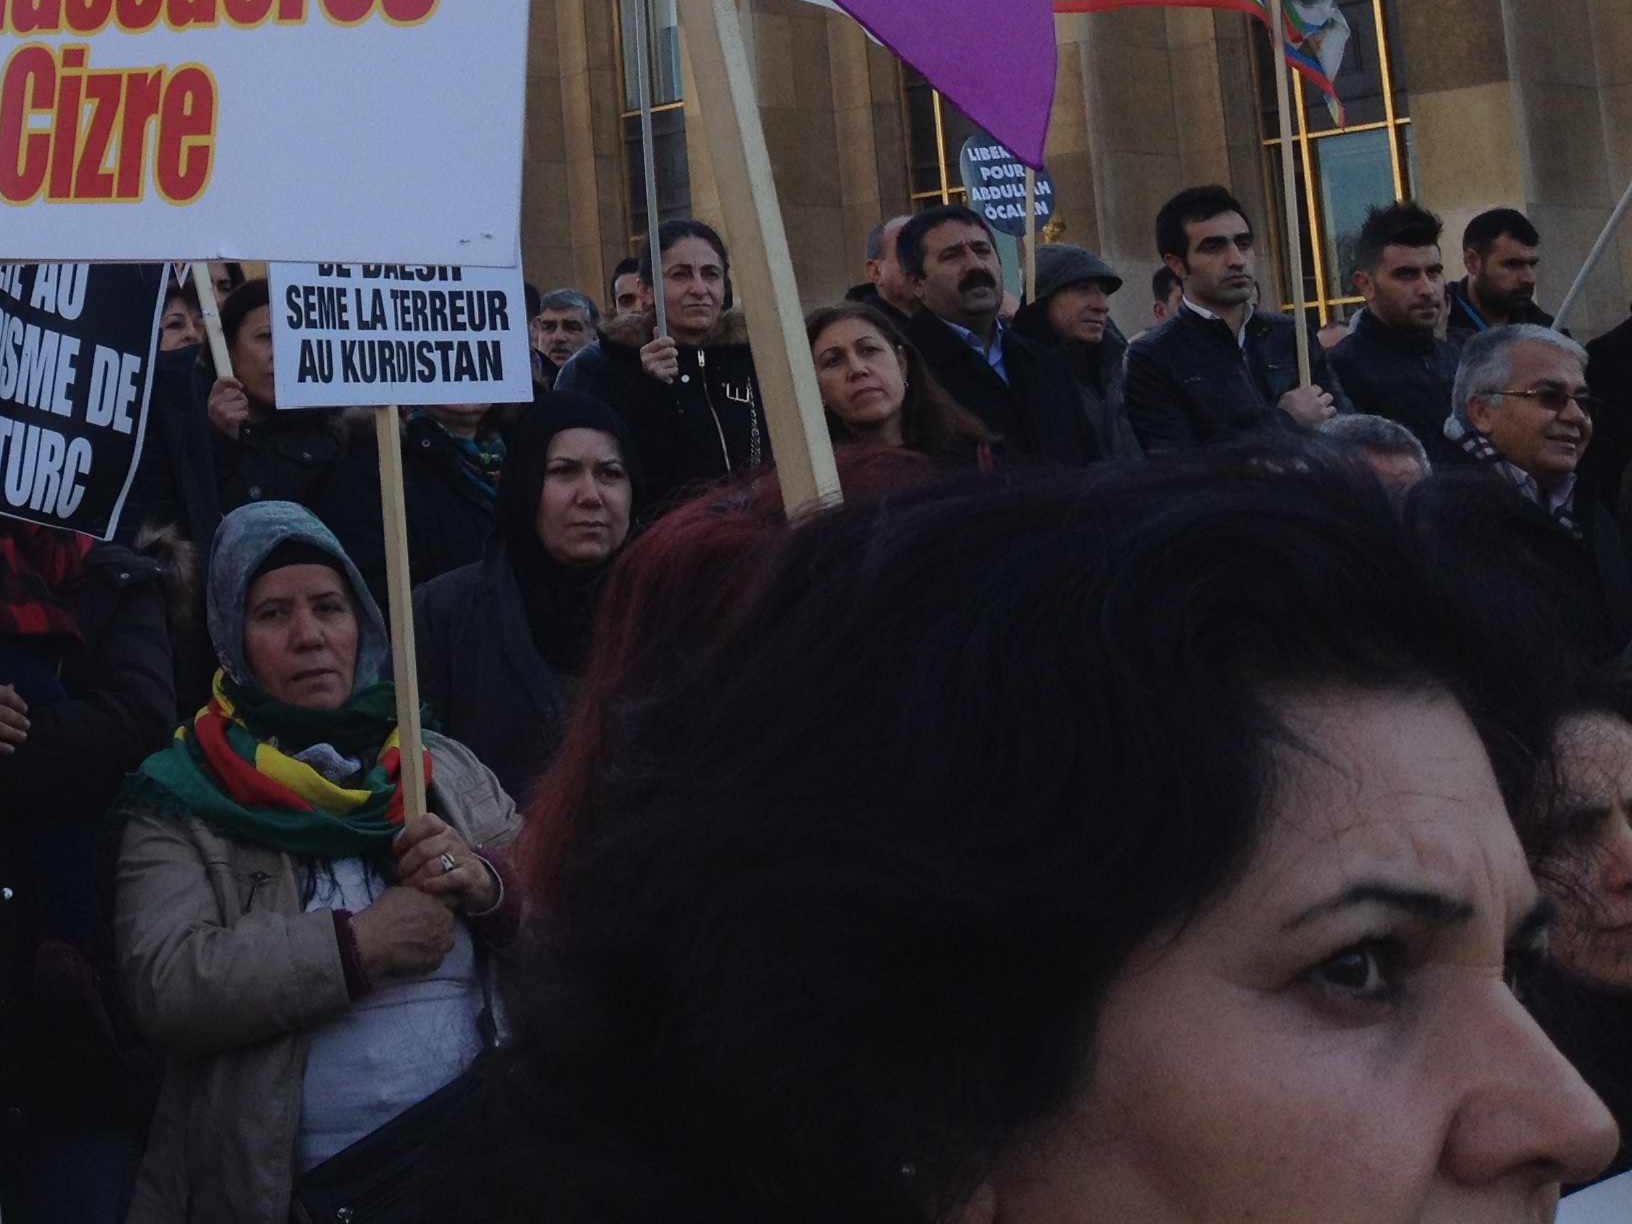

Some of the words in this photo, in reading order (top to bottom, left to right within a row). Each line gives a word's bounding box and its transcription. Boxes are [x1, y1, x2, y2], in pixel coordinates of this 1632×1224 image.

[972, 181, 1051, 201] ABDULLH
[979, 164, 1026, 180] POUR
[984, 201, 1049, 220] ÖCALN
[30, 264, 89, 320] AU
[286, 284, 349, 330] SEME
[355, 287, 388, 331] LA
[390, 288, 510, 332] TERREUR
[297, 339, 334, 384] AU
[341, 340, 504, 384] KURDISTAN
[85, 344, 141, 435] DE
